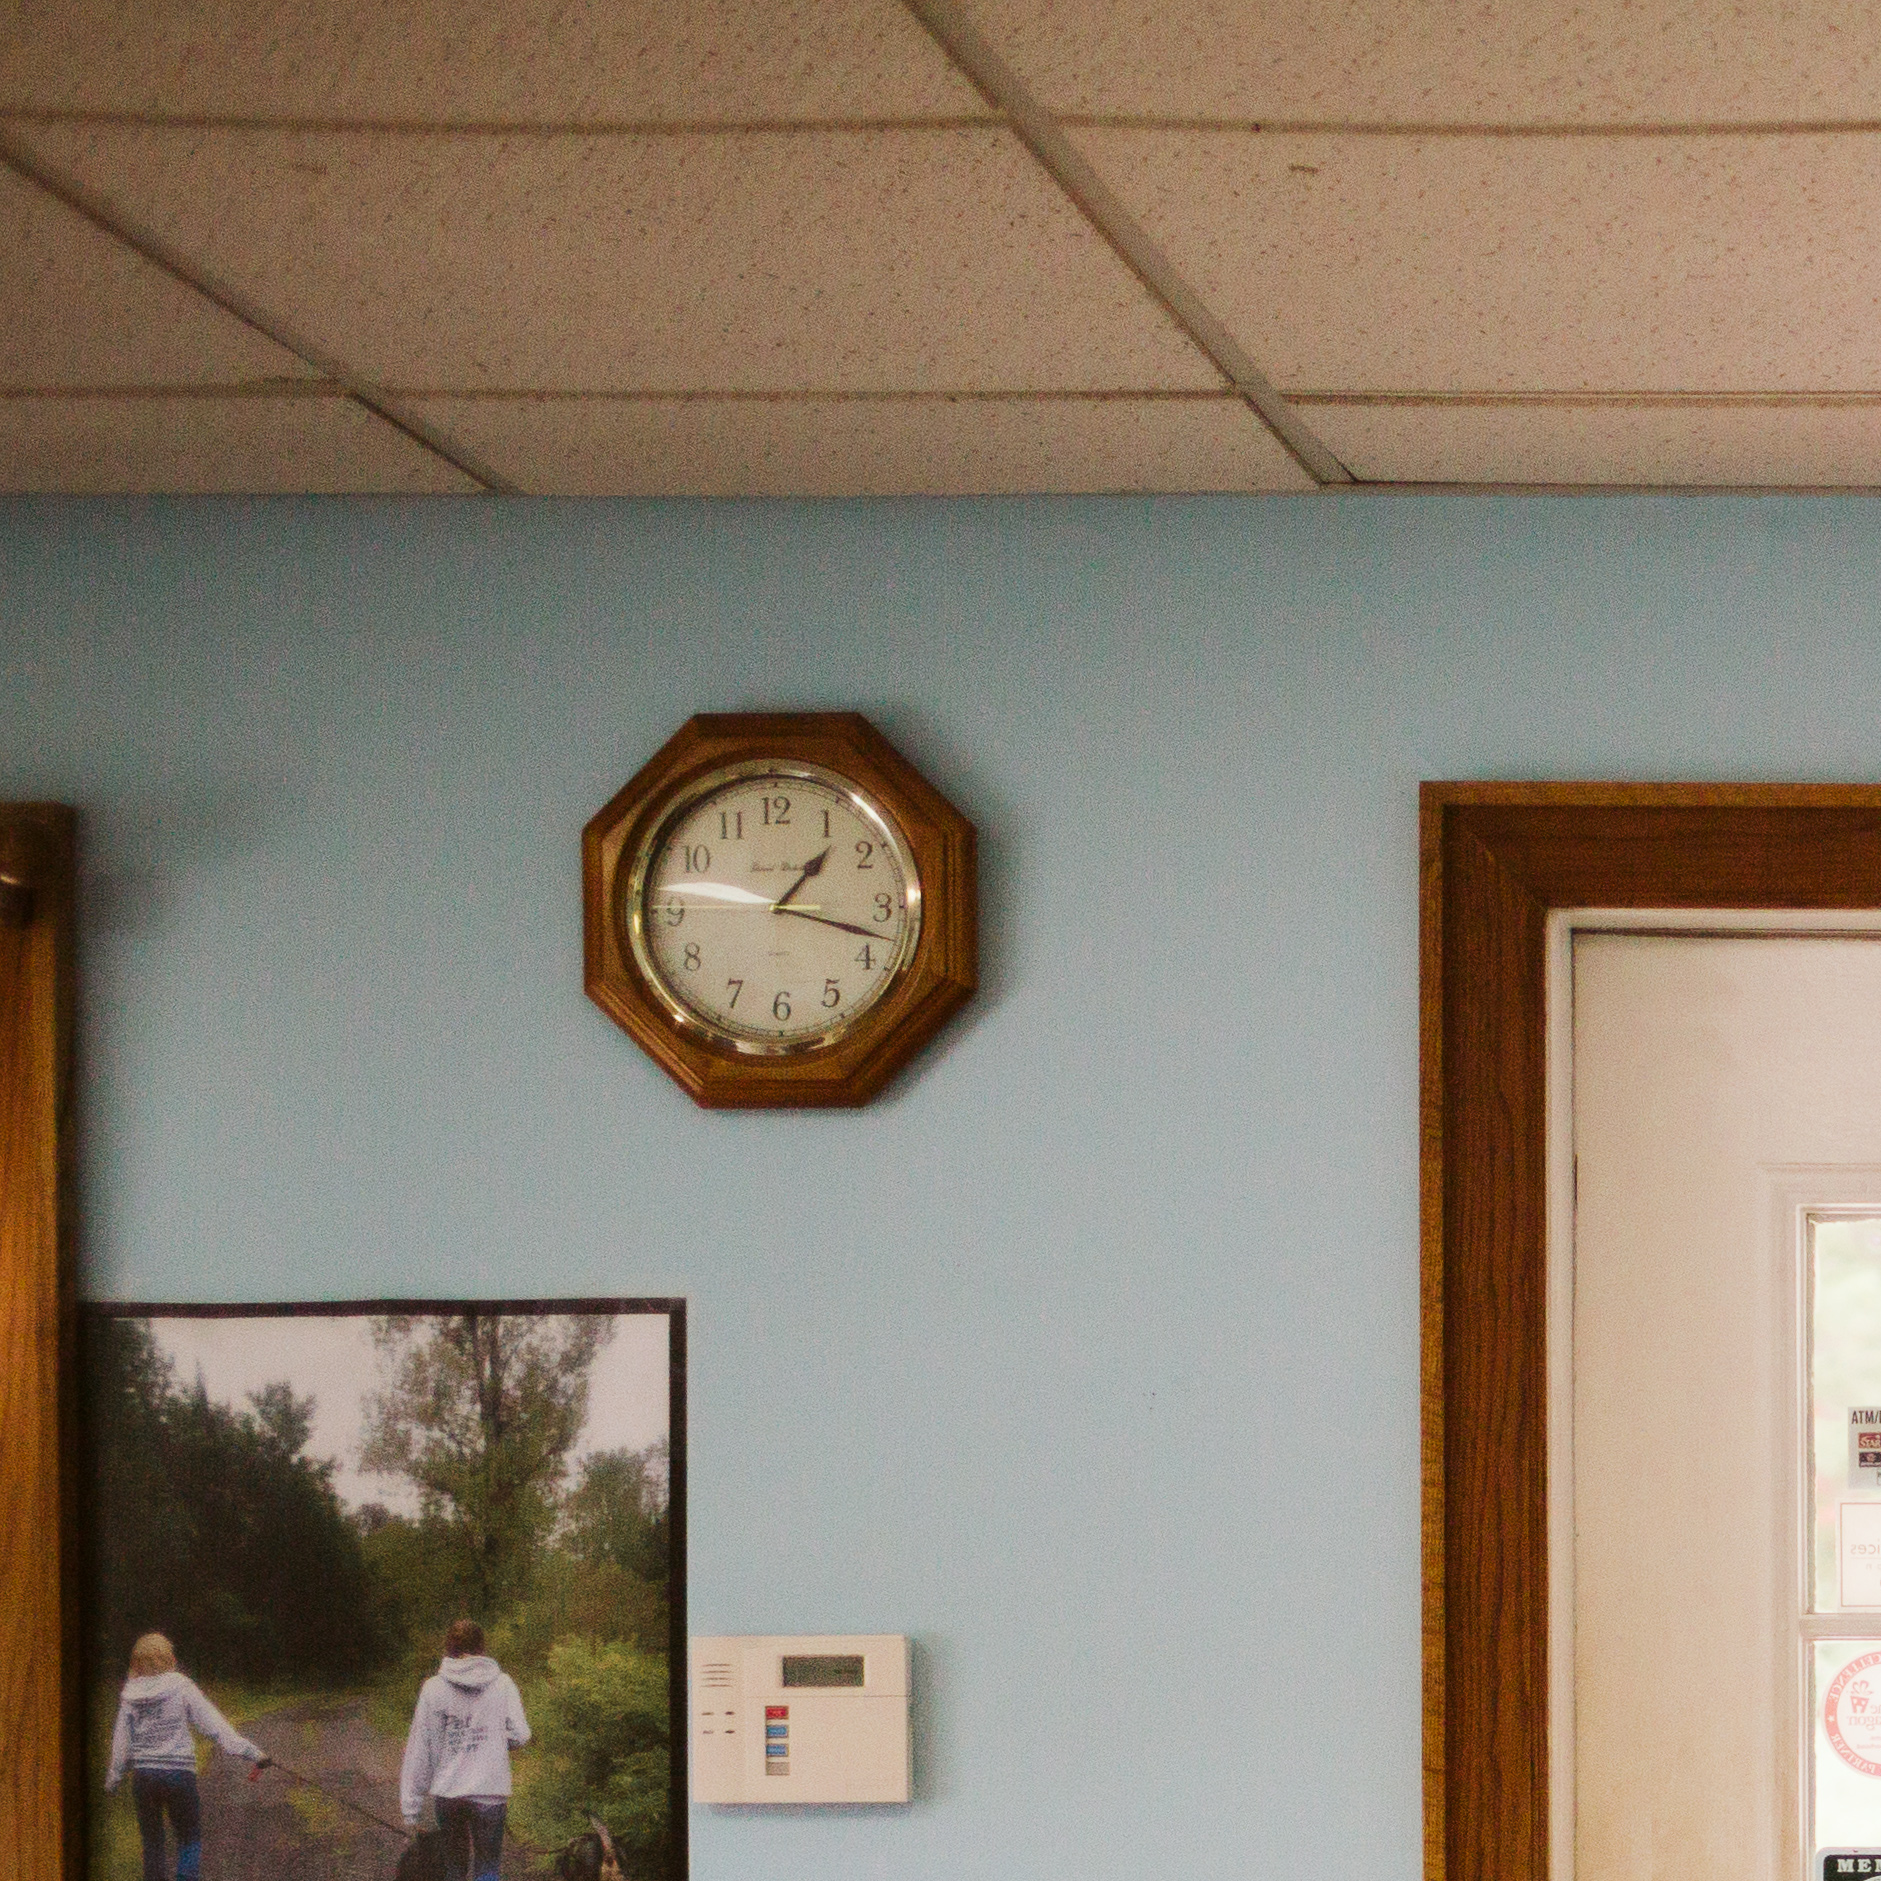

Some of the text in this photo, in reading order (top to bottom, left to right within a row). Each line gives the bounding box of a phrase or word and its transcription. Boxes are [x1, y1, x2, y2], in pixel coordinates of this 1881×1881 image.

[761, 796, 791, 825] 12
[822, 809, 832, 838] 1
[719, 812, 743, 839] 11
[684, 844, 711, 873] 10
[855, 841, 874, 869] 2
[666, 899, 685, 926] 9
[873, 893, 892, 922] 3
[683, 942, 701, 971] 8
[855, 944, 875, 970] 4
[726, 978, 743, 1009] 7
[772, 991, 791, 1021] 6
[822, 978, 841, 1008] 5
